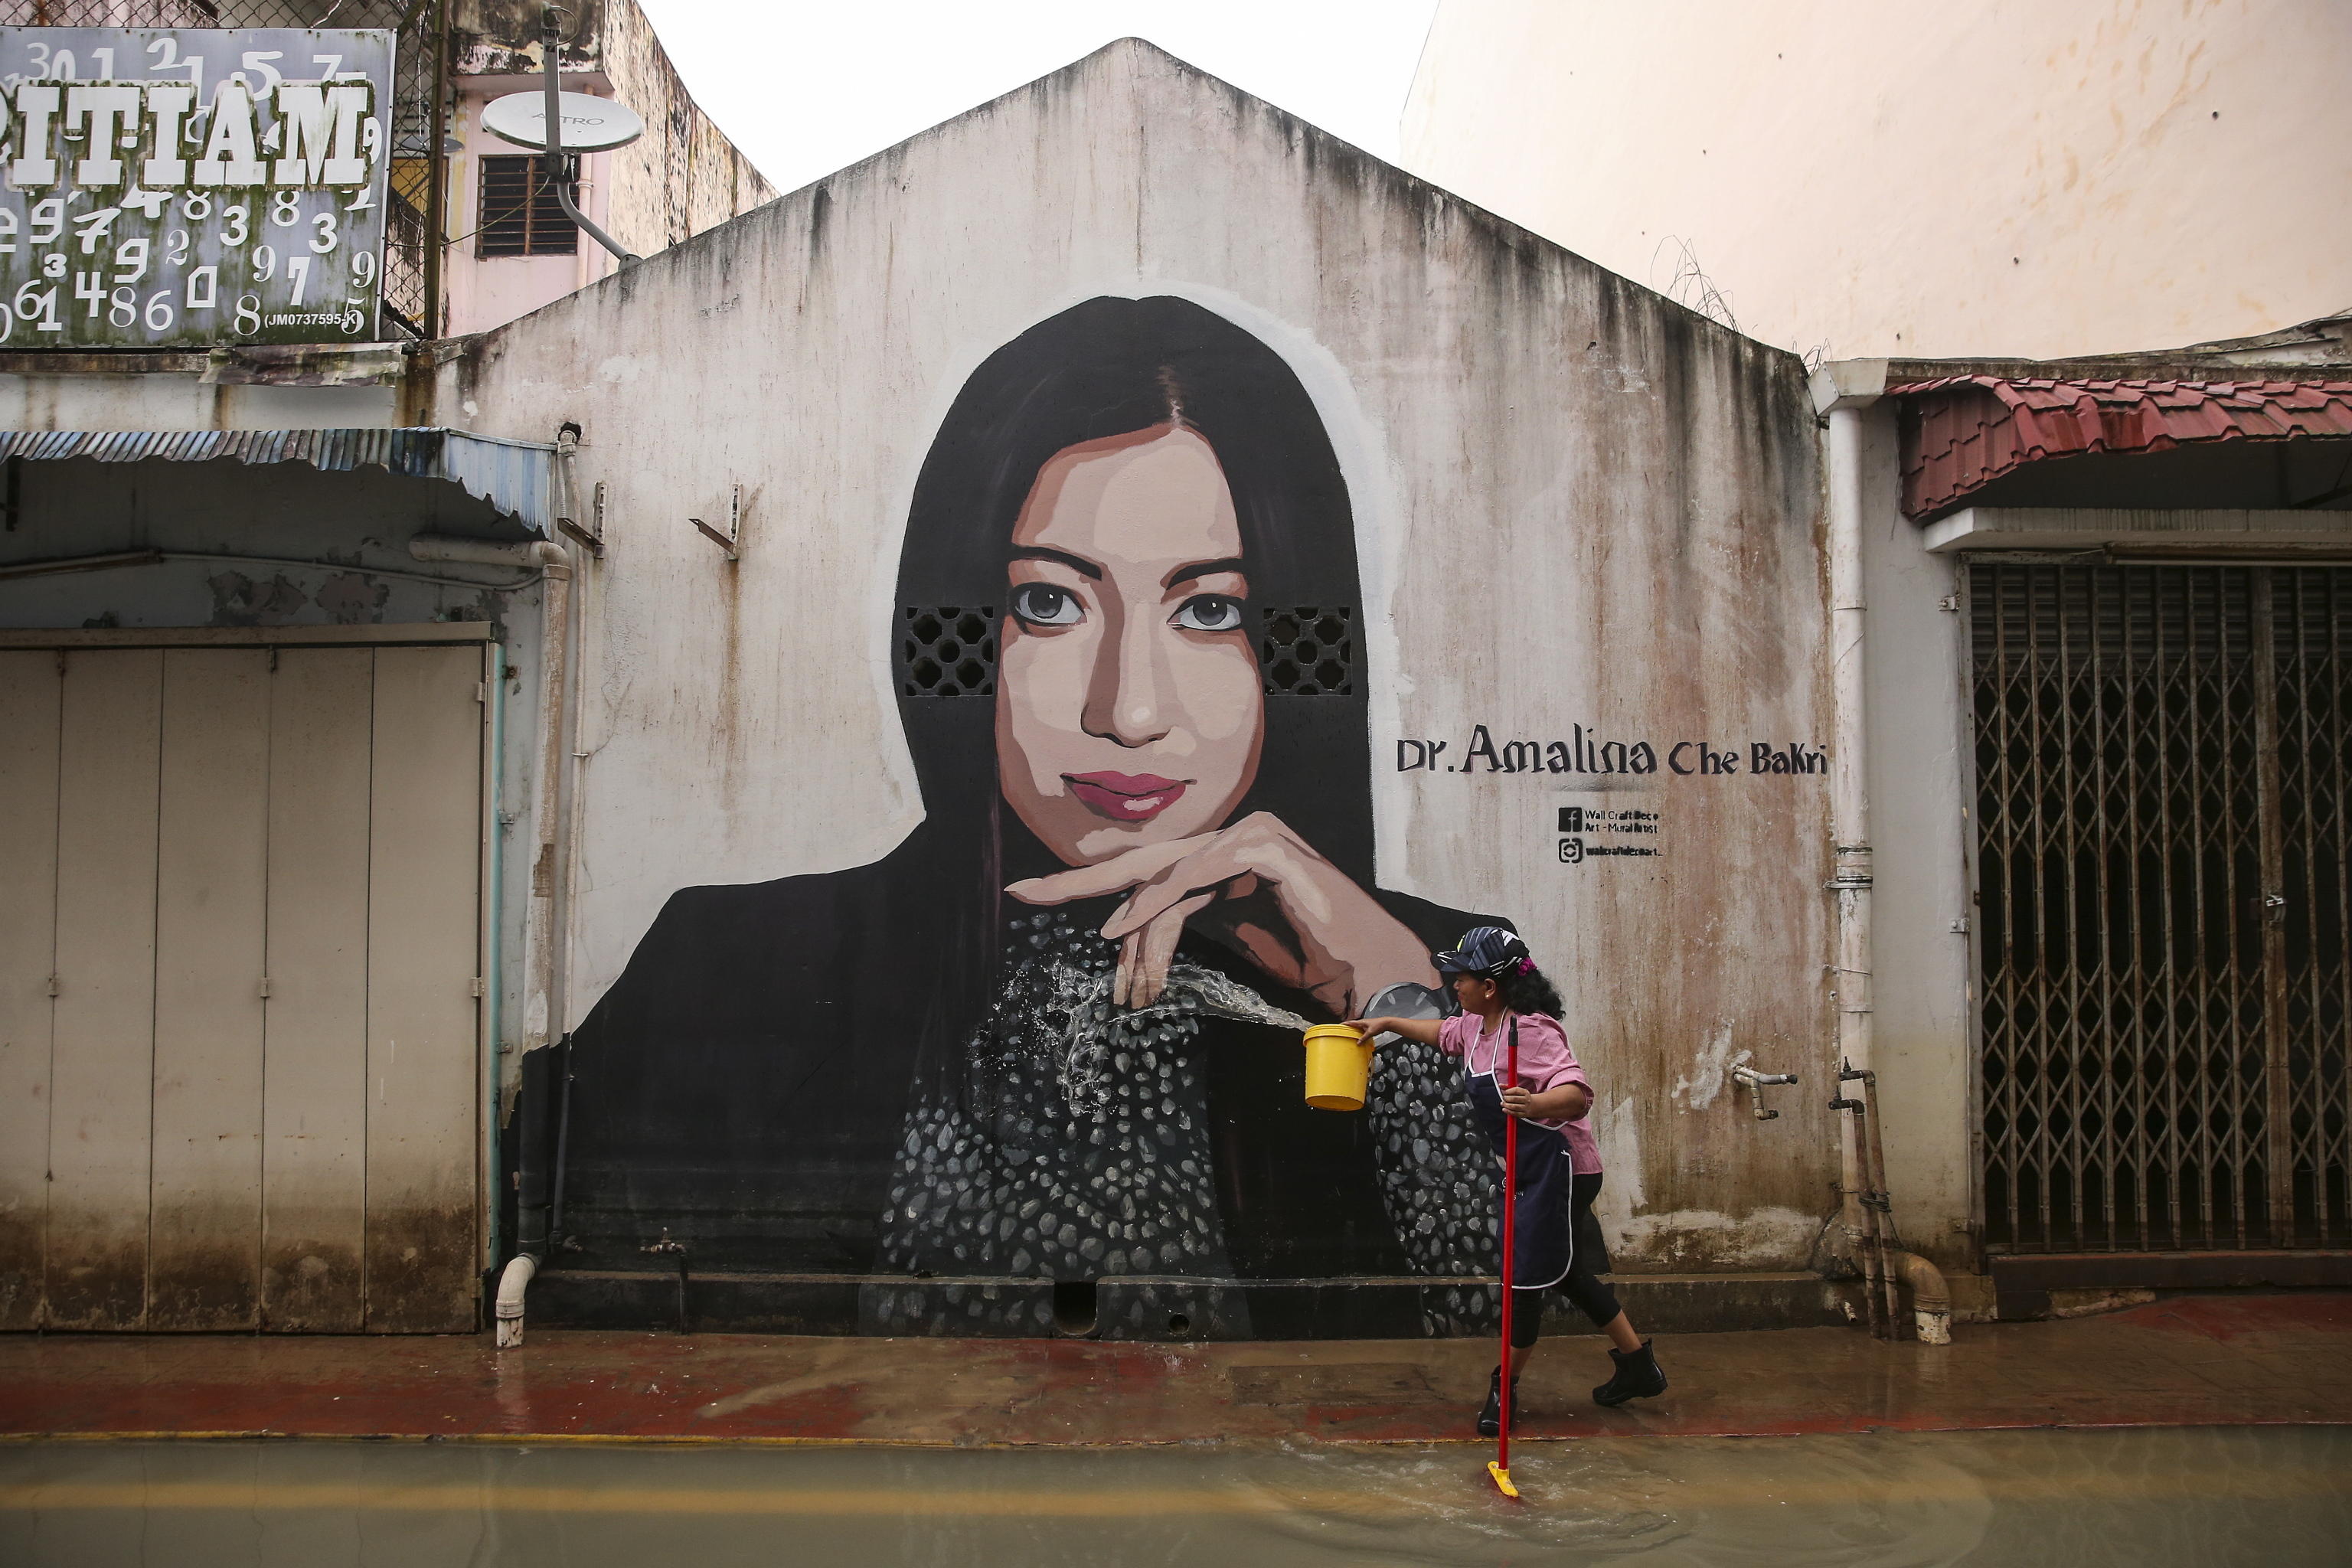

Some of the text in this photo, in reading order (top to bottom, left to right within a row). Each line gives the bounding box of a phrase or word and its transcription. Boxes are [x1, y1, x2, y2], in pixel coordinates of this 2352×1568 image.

[531, 113, 605, 125] ATRO
[0, 86, 368, 185] ITIAM
[1396, 740, 1455, 773] Dr.
[1459, 723, 1658, 774] Amalina
[1668, 741, 1740, 776] Che
[1585, 810, 1606, 821] Wall
[1608, 810, 1632, 821] Craft
[1585, 822, 1599, 832] Art
[1608, 822, 1632, 833] Mural
